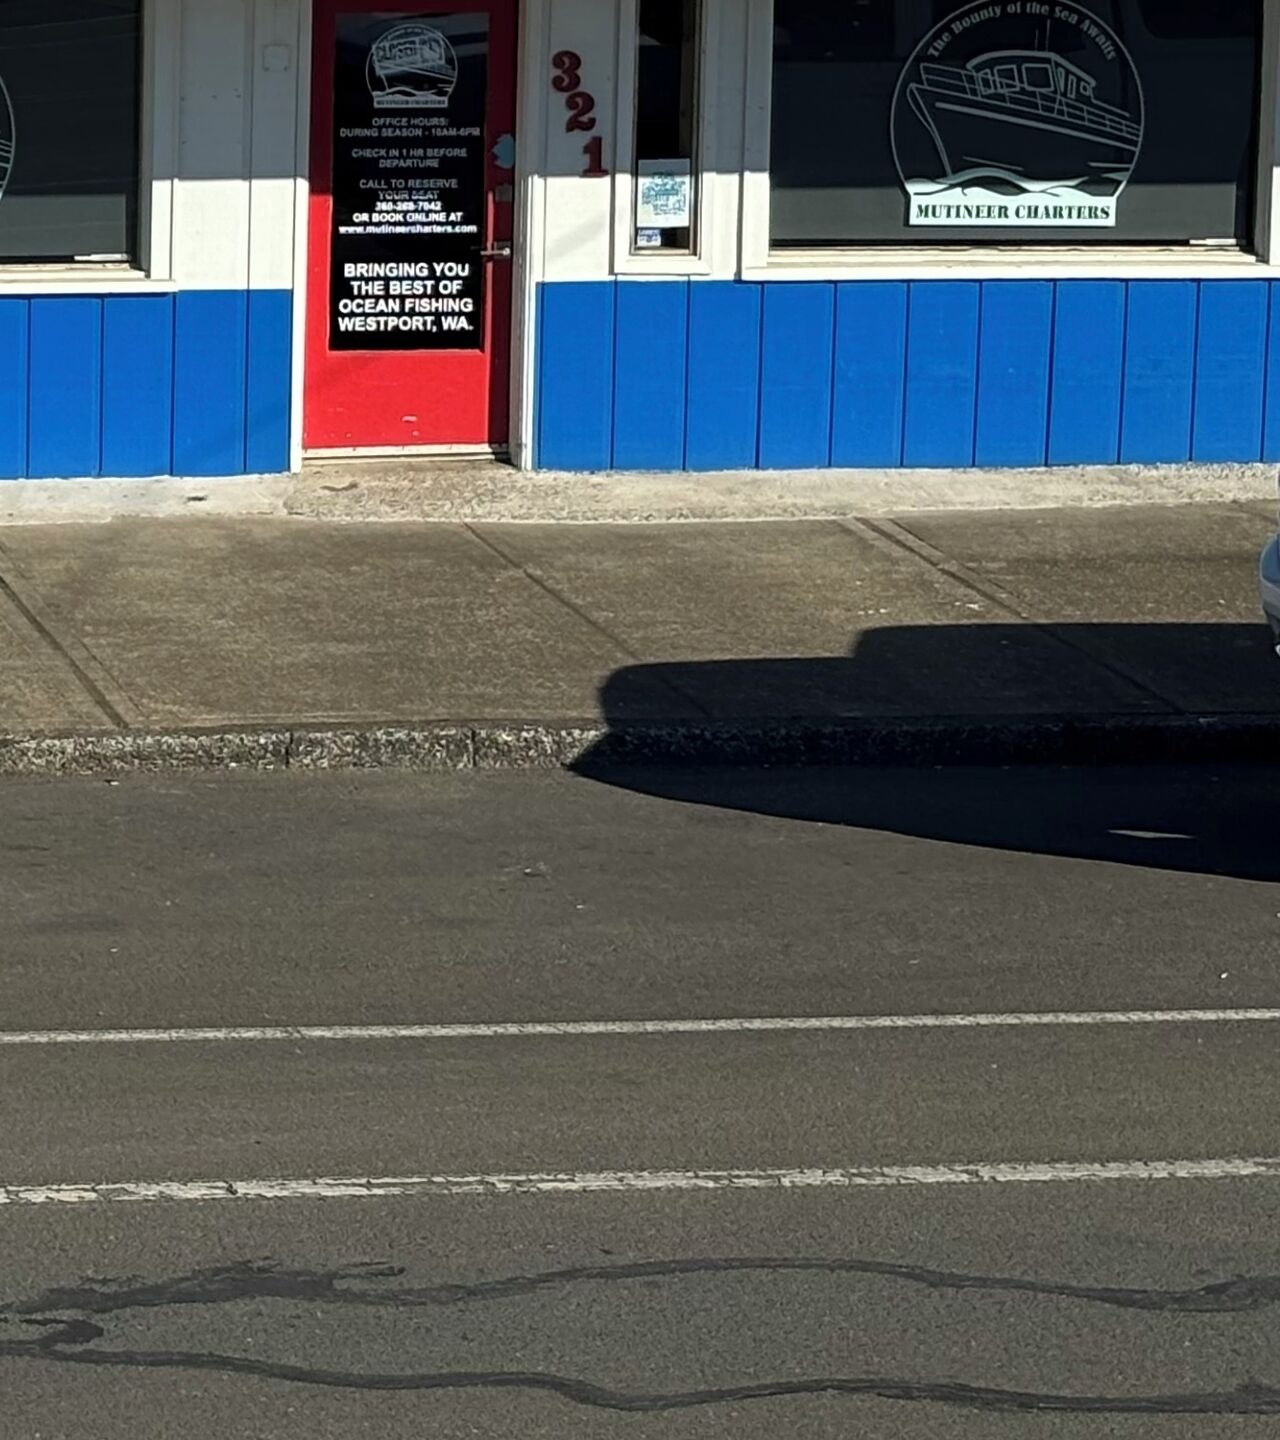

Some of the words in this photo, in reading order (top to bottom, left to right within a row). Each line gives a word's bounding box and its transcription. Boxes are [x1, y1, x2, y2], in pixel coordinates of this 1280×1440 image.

[927, 32, 952, 58] The
[950, 4, 1002, 35] Bounty
[1007, 1, 1022, 14] of
[1026, 1, 1050, 15] the
[1054, 6, 1079, 25] Sea
[1080, 19, 1119, 61] Awaits
[372, 117, 408, 126] OFFICE
[340, 128, 378, 137] DURING
[381, 128, 423, 137] SEASON
[352, 148, 386, 157] CHECK
[389, 148, 399, 157] IN
[402, 148, 406, 157] 1
[410, 148, 424, 157] HR
[426, 148, 467, 157] BEFORE
[379, 159, 439, 168] DEPARTURE
[360, 179, 388, 189] CALL
[391, 179, 405, 189] TO
[408, 179, 458, 189] RESERVE
[378, 190, 409, 200] YOUR
[412, 190, 439, 200] SEAT
[352, 212, 369, 222] OR
[372, 212, 404, 222] BOOK
[406, 212, 447, 222] ONLINE
[448, 212, 463, 222] AT
[916, 204, 1009, 219] MUTINEER
[1015, 204, 1110, 220] CHARTERS
[344, 262, 429, 277] BRINGING
[432, 262, 469, 277] YOU
[350, 280, 385, 295] THE
[389, 280, 435, 295] BEST
[438, 280, 463, 295] OF
[339, 298, 400, 313] OCEAN
[405, 298, 473, 313] FISHING
[338, 316, 437, 333] WESTPORT,
[441, 316, 474, 331] WA.
